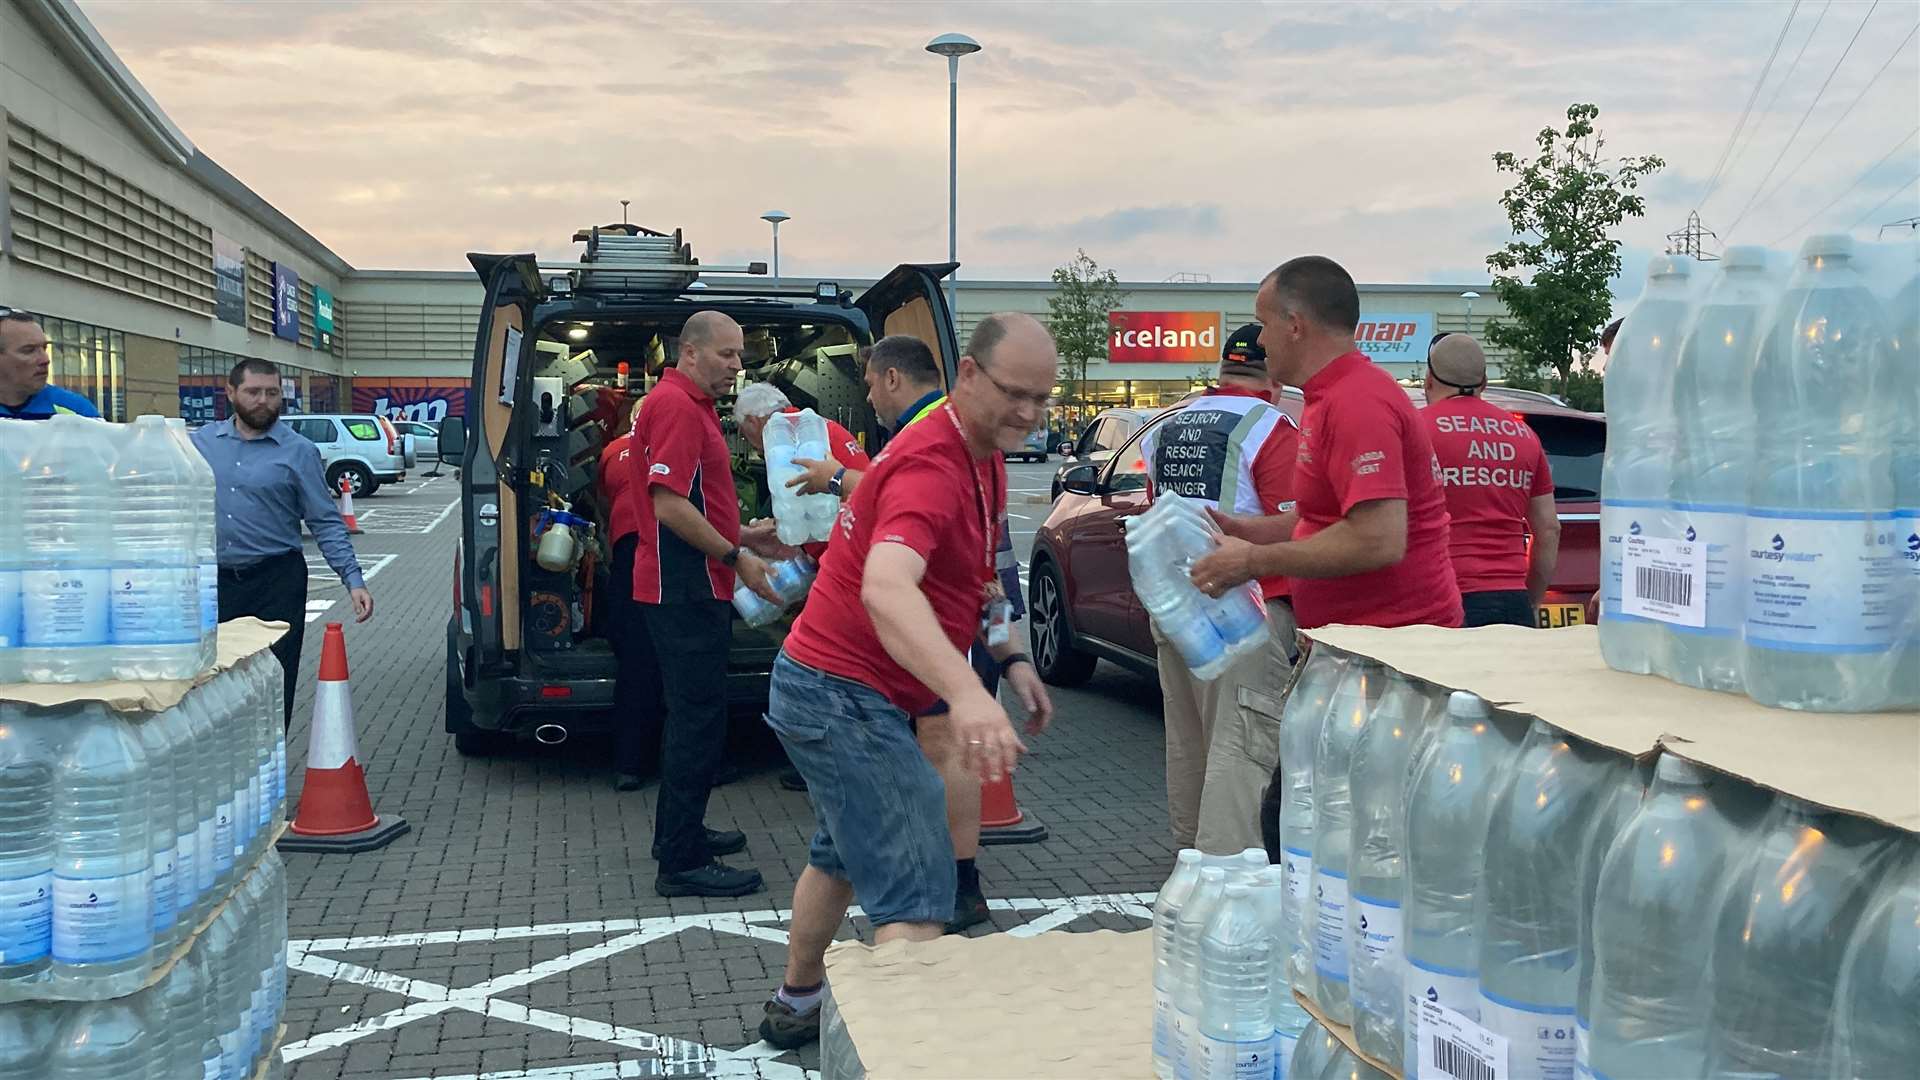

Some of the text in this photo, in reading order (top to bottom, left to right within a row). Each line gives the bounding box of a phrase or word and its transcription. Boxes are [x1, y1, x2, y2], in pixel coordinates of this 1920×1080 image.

[1114, 326, 1215, 348] iceland
[1354, 322, 1417, 341] nap
[1175, 412, 1222, 425] SEARCH
[1436, 415, 1531, 439] SEARCH
[1178, 428, 1202, 441] AND
[1165, 445, 1208, 459] RESCUE
[1467, 439, 1516, 461] AND
[1443, 466, 1534, 490] RESCUE
